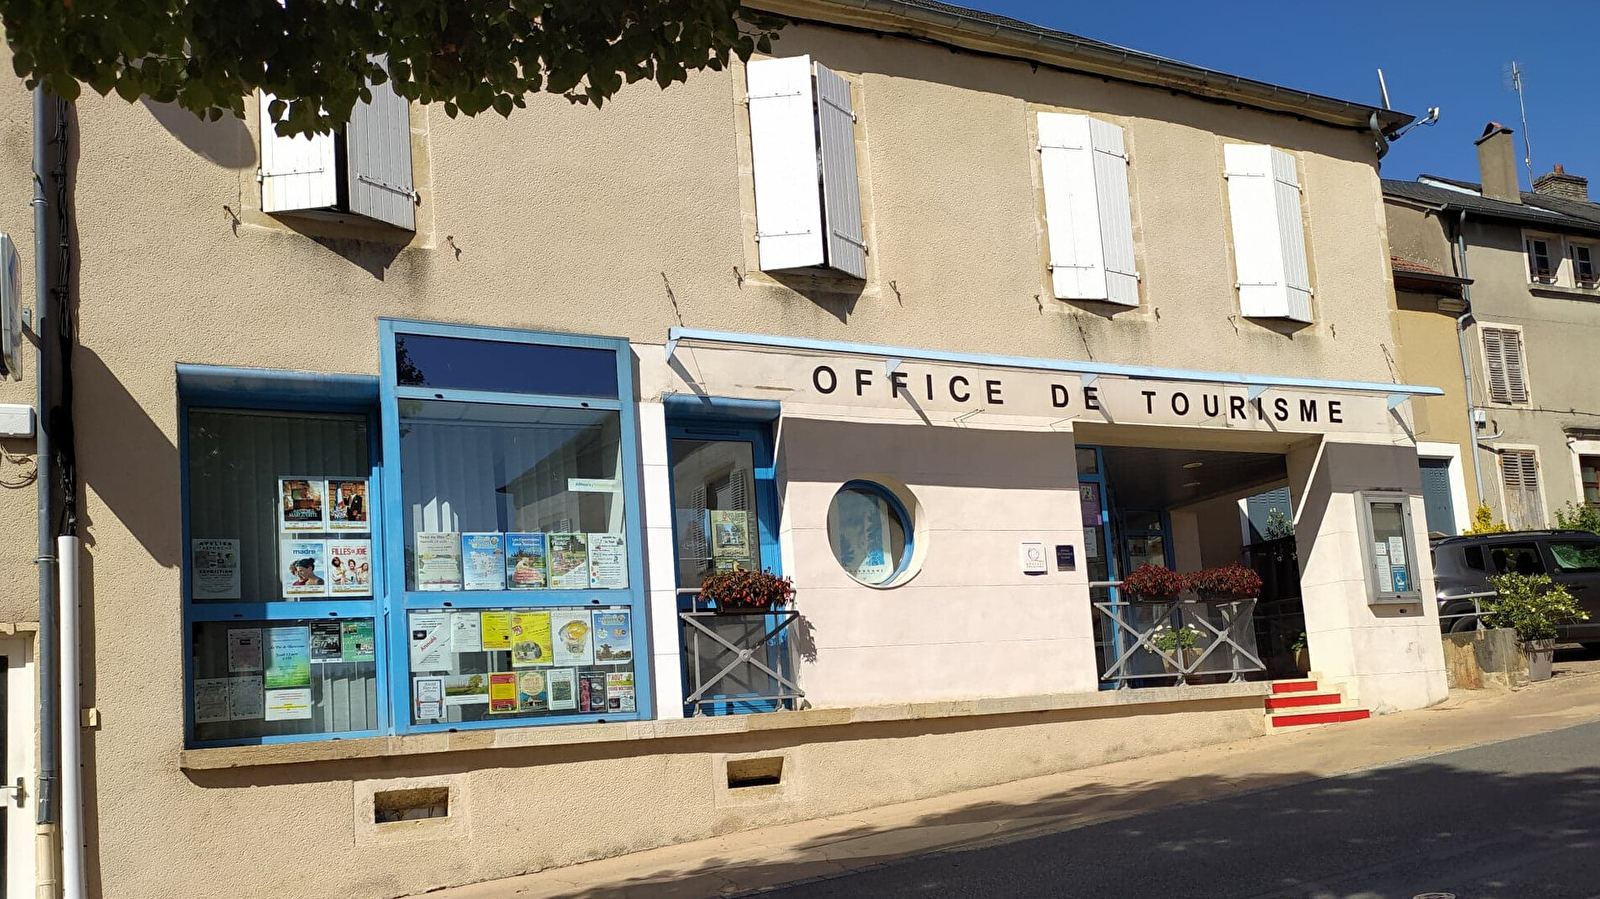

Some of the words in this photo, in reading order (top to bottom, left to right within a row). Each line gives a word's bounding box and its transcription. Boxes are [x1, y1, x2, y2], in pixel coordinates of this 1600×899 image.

[812, 365, 1004, 405] OFFICE
[1051, 384, 1100, 411] DE
[1141, 390, 1343, 423] TOURISME
[331, 547, 351, 556] FILLES
[355, 547, 368, 556] JOIE
